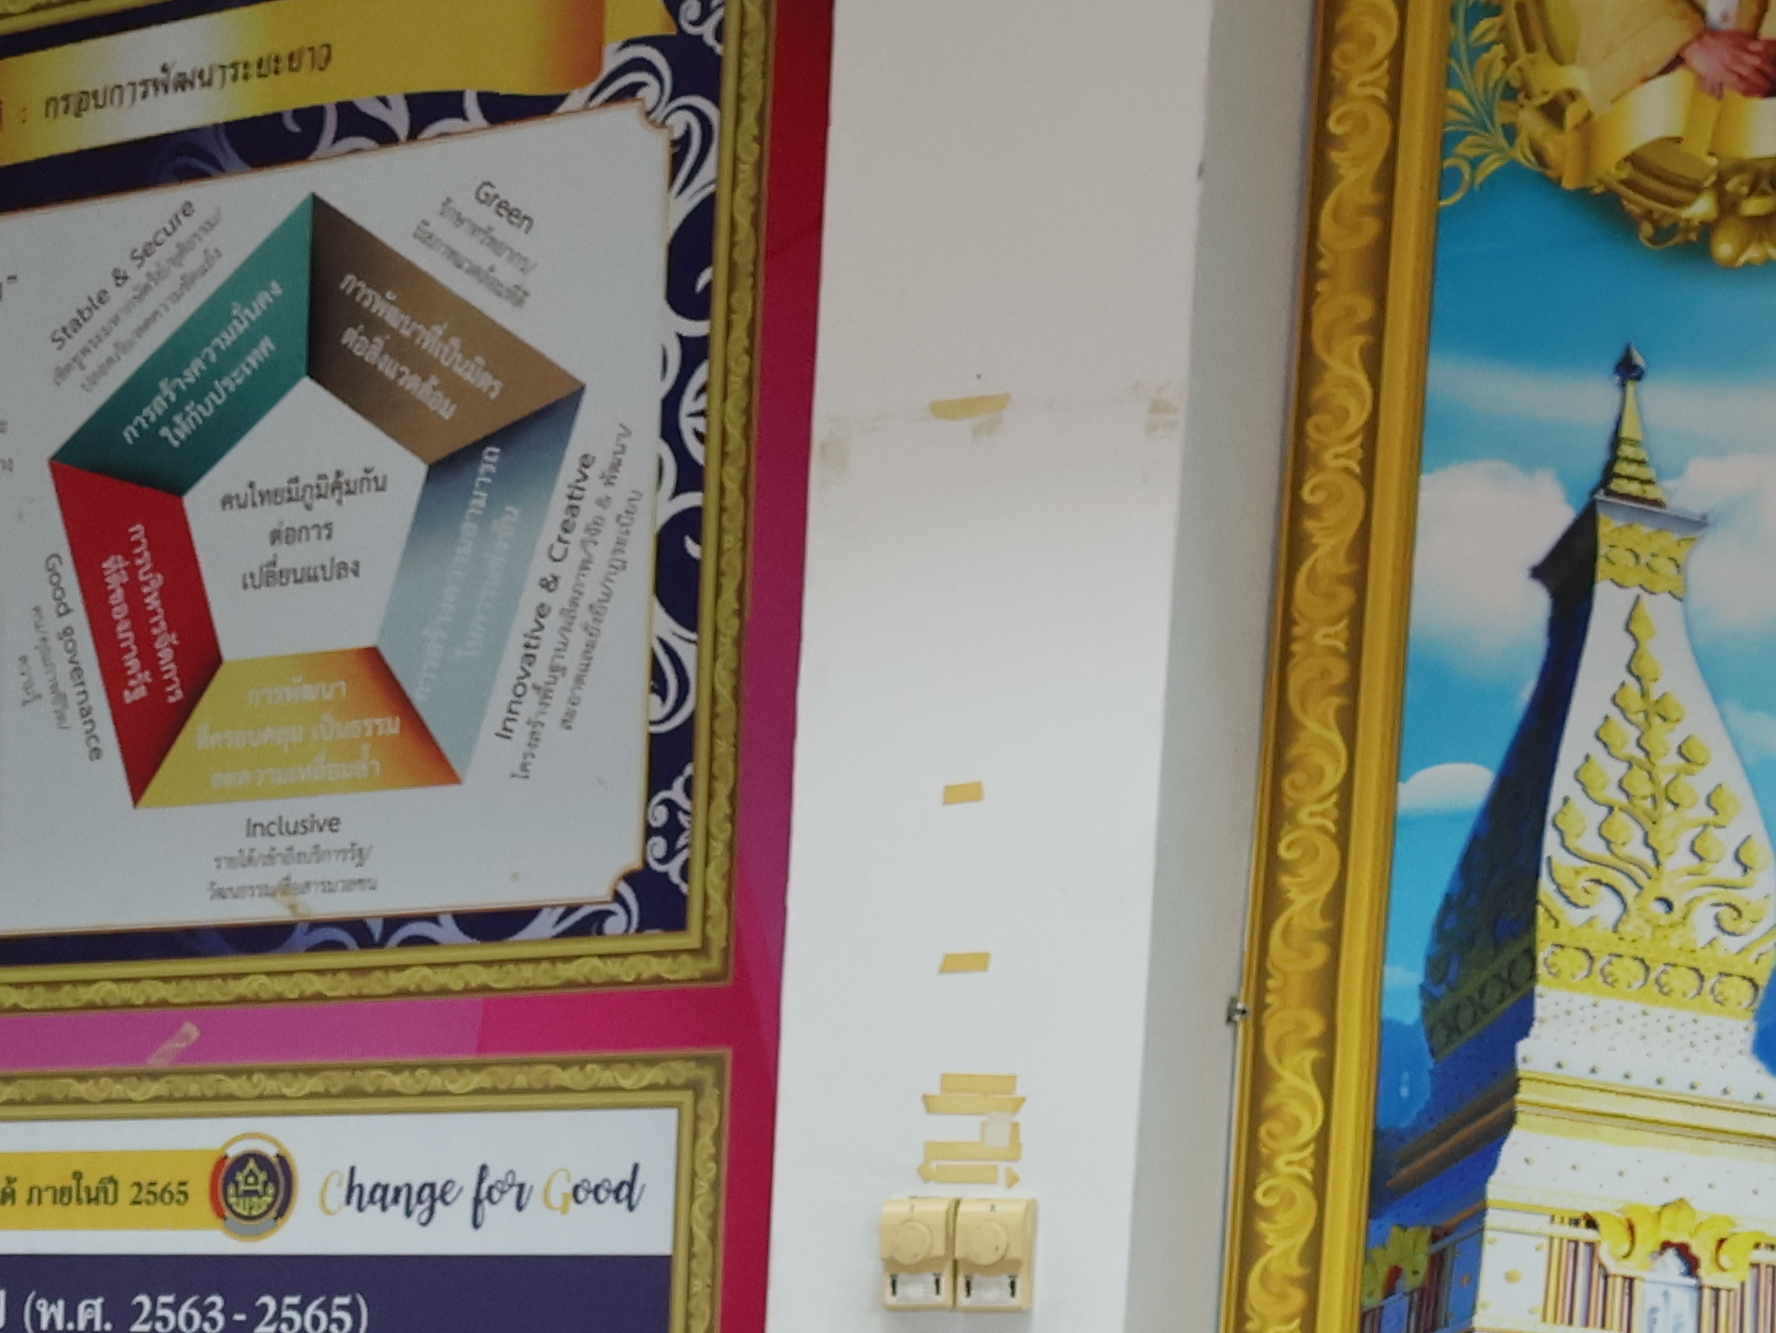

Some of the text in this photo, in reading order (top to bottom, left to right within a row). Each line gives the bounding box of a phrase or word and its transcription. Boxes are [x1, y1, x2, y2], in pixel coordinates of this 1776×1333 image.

[474, 180, 535, 235] Green
[50, 286, 112, 350] Stable
[110, 266, 132, 289] &
[129, 200, 197, 270] Secure
[269, 520, 334, 547] ต่อการ
[241, 553, 361, 592] เปลี่ยนแปลง
[494, 452, 596, 741] Innovative & Creative
[45, 552, 104, 762] Good governance
[245, 814, 342, 839] Inclusive
[25, 1169, 120, 1209] ภายในปี
[129, 1180, 190, 1208] 2565
[318, 1162, 647, 1230] Change for Good
